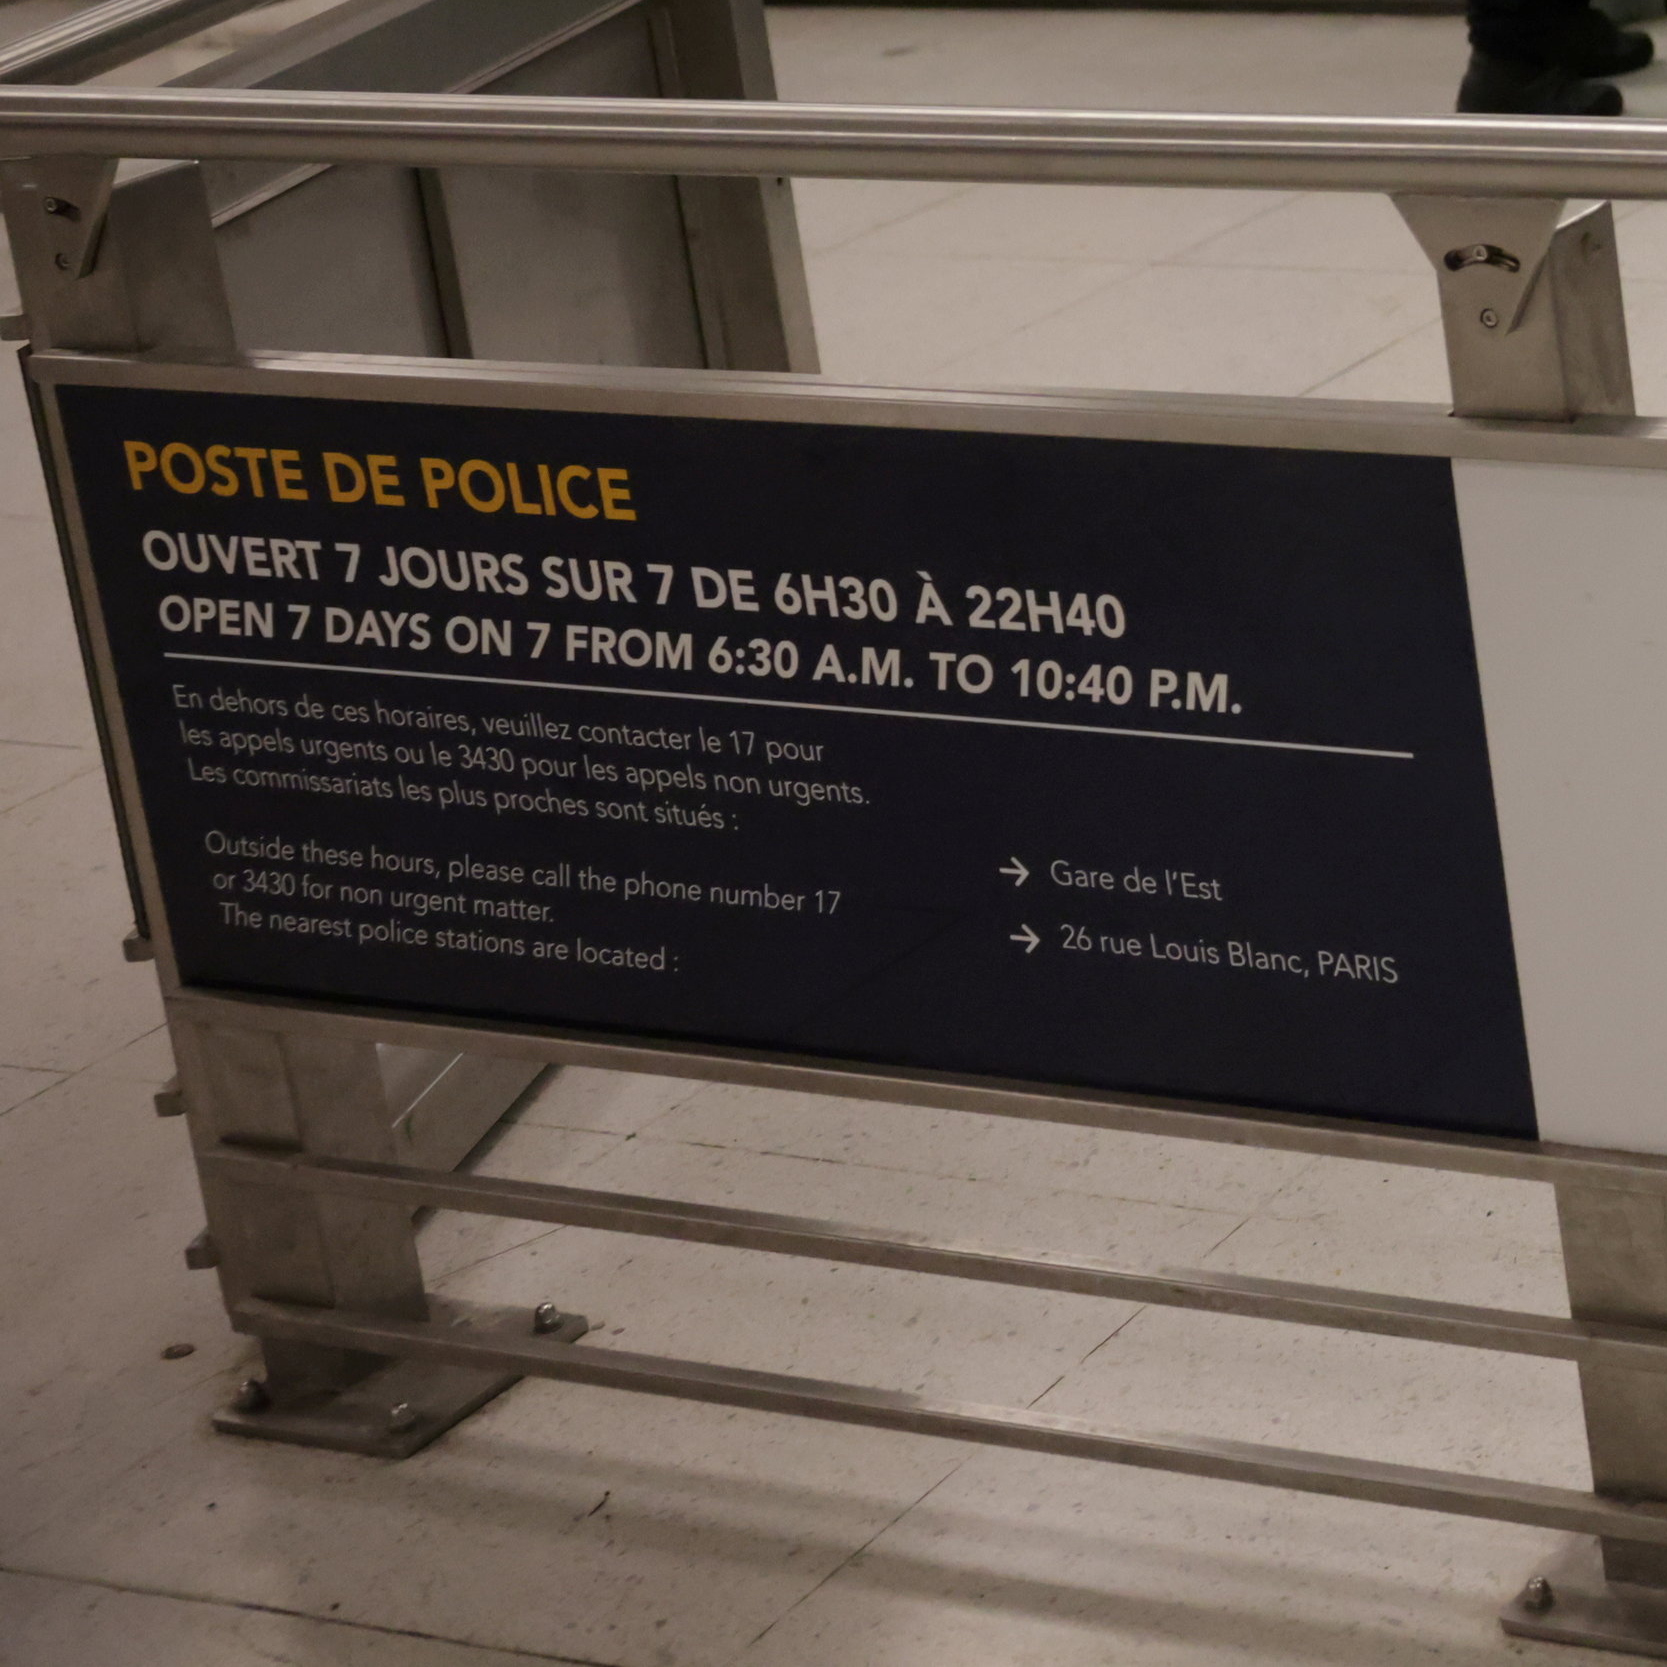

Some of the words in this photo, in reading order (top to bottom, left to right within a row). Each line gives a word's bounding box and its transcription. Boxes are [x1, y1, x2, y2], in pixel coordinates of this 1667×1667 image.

[123, 440, 309, 501] POSTE
[322, 451, 406, 507] DE
[419, 457, 637, 522] POLICE
[142, 529, 322, 581] OUVERT
[334, 542, 361, 583] 7
[378, 545, 529, 596] JOURS
[541, 555, 638, 603] SUR
[646, 563, 674, 605] 7
[690, 566, 760, 612] DE
[774, 572, 898, 622] 6H30
[915, 570, 954, 626] À
[965, 584, 1126, 639] 22H40
[158, 594, 274, 638] OPEN
[287, 604, 311, 640] 7
[325, 606, 432, 651] DAYS
[444, 615, 512, 657] ON
[526, 621, 551, 659] 7
[566, 624, 693, 671] FROM
[707, 635, 799, 679] 6:30
[812, 643, 914, 688] A.M.
[928, 651, 994, 694] TO
[1011, 658, 1134, 706] 10:40
[1149, 668, 1242, 715] P.M.
[172, 684, 202, 708] En
[209, 688, 288, 716] dehors
[294, 694, 324, 719] de
[332, 704, 370, 723] ces
[374, 700, 476, 735] horaires,
[482, 713, 572, 740] veuillez
[578, 725, 691, 750] contacter
[699, 726, 721, 753] le
[729, 730, 755, 755] 17
[766, 741, 824, 764] pour
[180, 721, 212, 746] les
[220, 729, 295, 755] appels
[301, 739, 388, 763] urgents
[395, 747, 424, 764] ou
[430, 741, 452, 767] le
[458, 744, 515, 772] 3430
[521, 757, 576, 780] pour
[584, 755, 618, 782] les
[626, 764, 707, 792] appels
[714, 774, 761, 794] non
[768, 780, 870, 806] urgents.
[188, 758, 226, 783] Les
[233, 769, 393, 798] commissariats
[399, 776, 432, 802] les
[438, 780, 487, 809] plus
[493, 789, 589, 816] proches
[595, 801, 648, 822] sont
[654, 804, 725, 829] situés
[205, 830, 294, 860] Outside
[302, 840, 363, 867] these
[371, 845, 440, 878] hours,
[449, 854, 524, 883] please
[532, 863, 570, 887] call
[578, 866, 617, 893] the
[624, 871, 702, 901] phone
[710, 883, 805, 911] number
[815, 890, 841, 914] 17
[213, 873, 235, 889] or
[244, 869, 295, 896] 3430
[302, 874, 332, 899] for
[340, 886, 382, 904] non
[391, 892, 466, 916] urgent
[474, 899, 555, 922] matter.
[1050, 859, 1114, 890] Gare
[1123, 866, 1157, 894] de
[1165, 869, 1223, 901] l'Est
[220, 902, 262, 928] The
[270, 914, 351, 938] nearest
[359, 919, 428, 946] police
[436, 930, 525, 956] stations
[532, 941, 569, 960] are
[577, 938, 665, 971] located
[1060, 924, 1092, 951] 26
[1100, 936, 1142, 957] rue
[1150, 933, 1220, 965] Louis
[1227, 941, 1309, 978] Blanc,
[1317, 950, 1398, 984] PARIS
